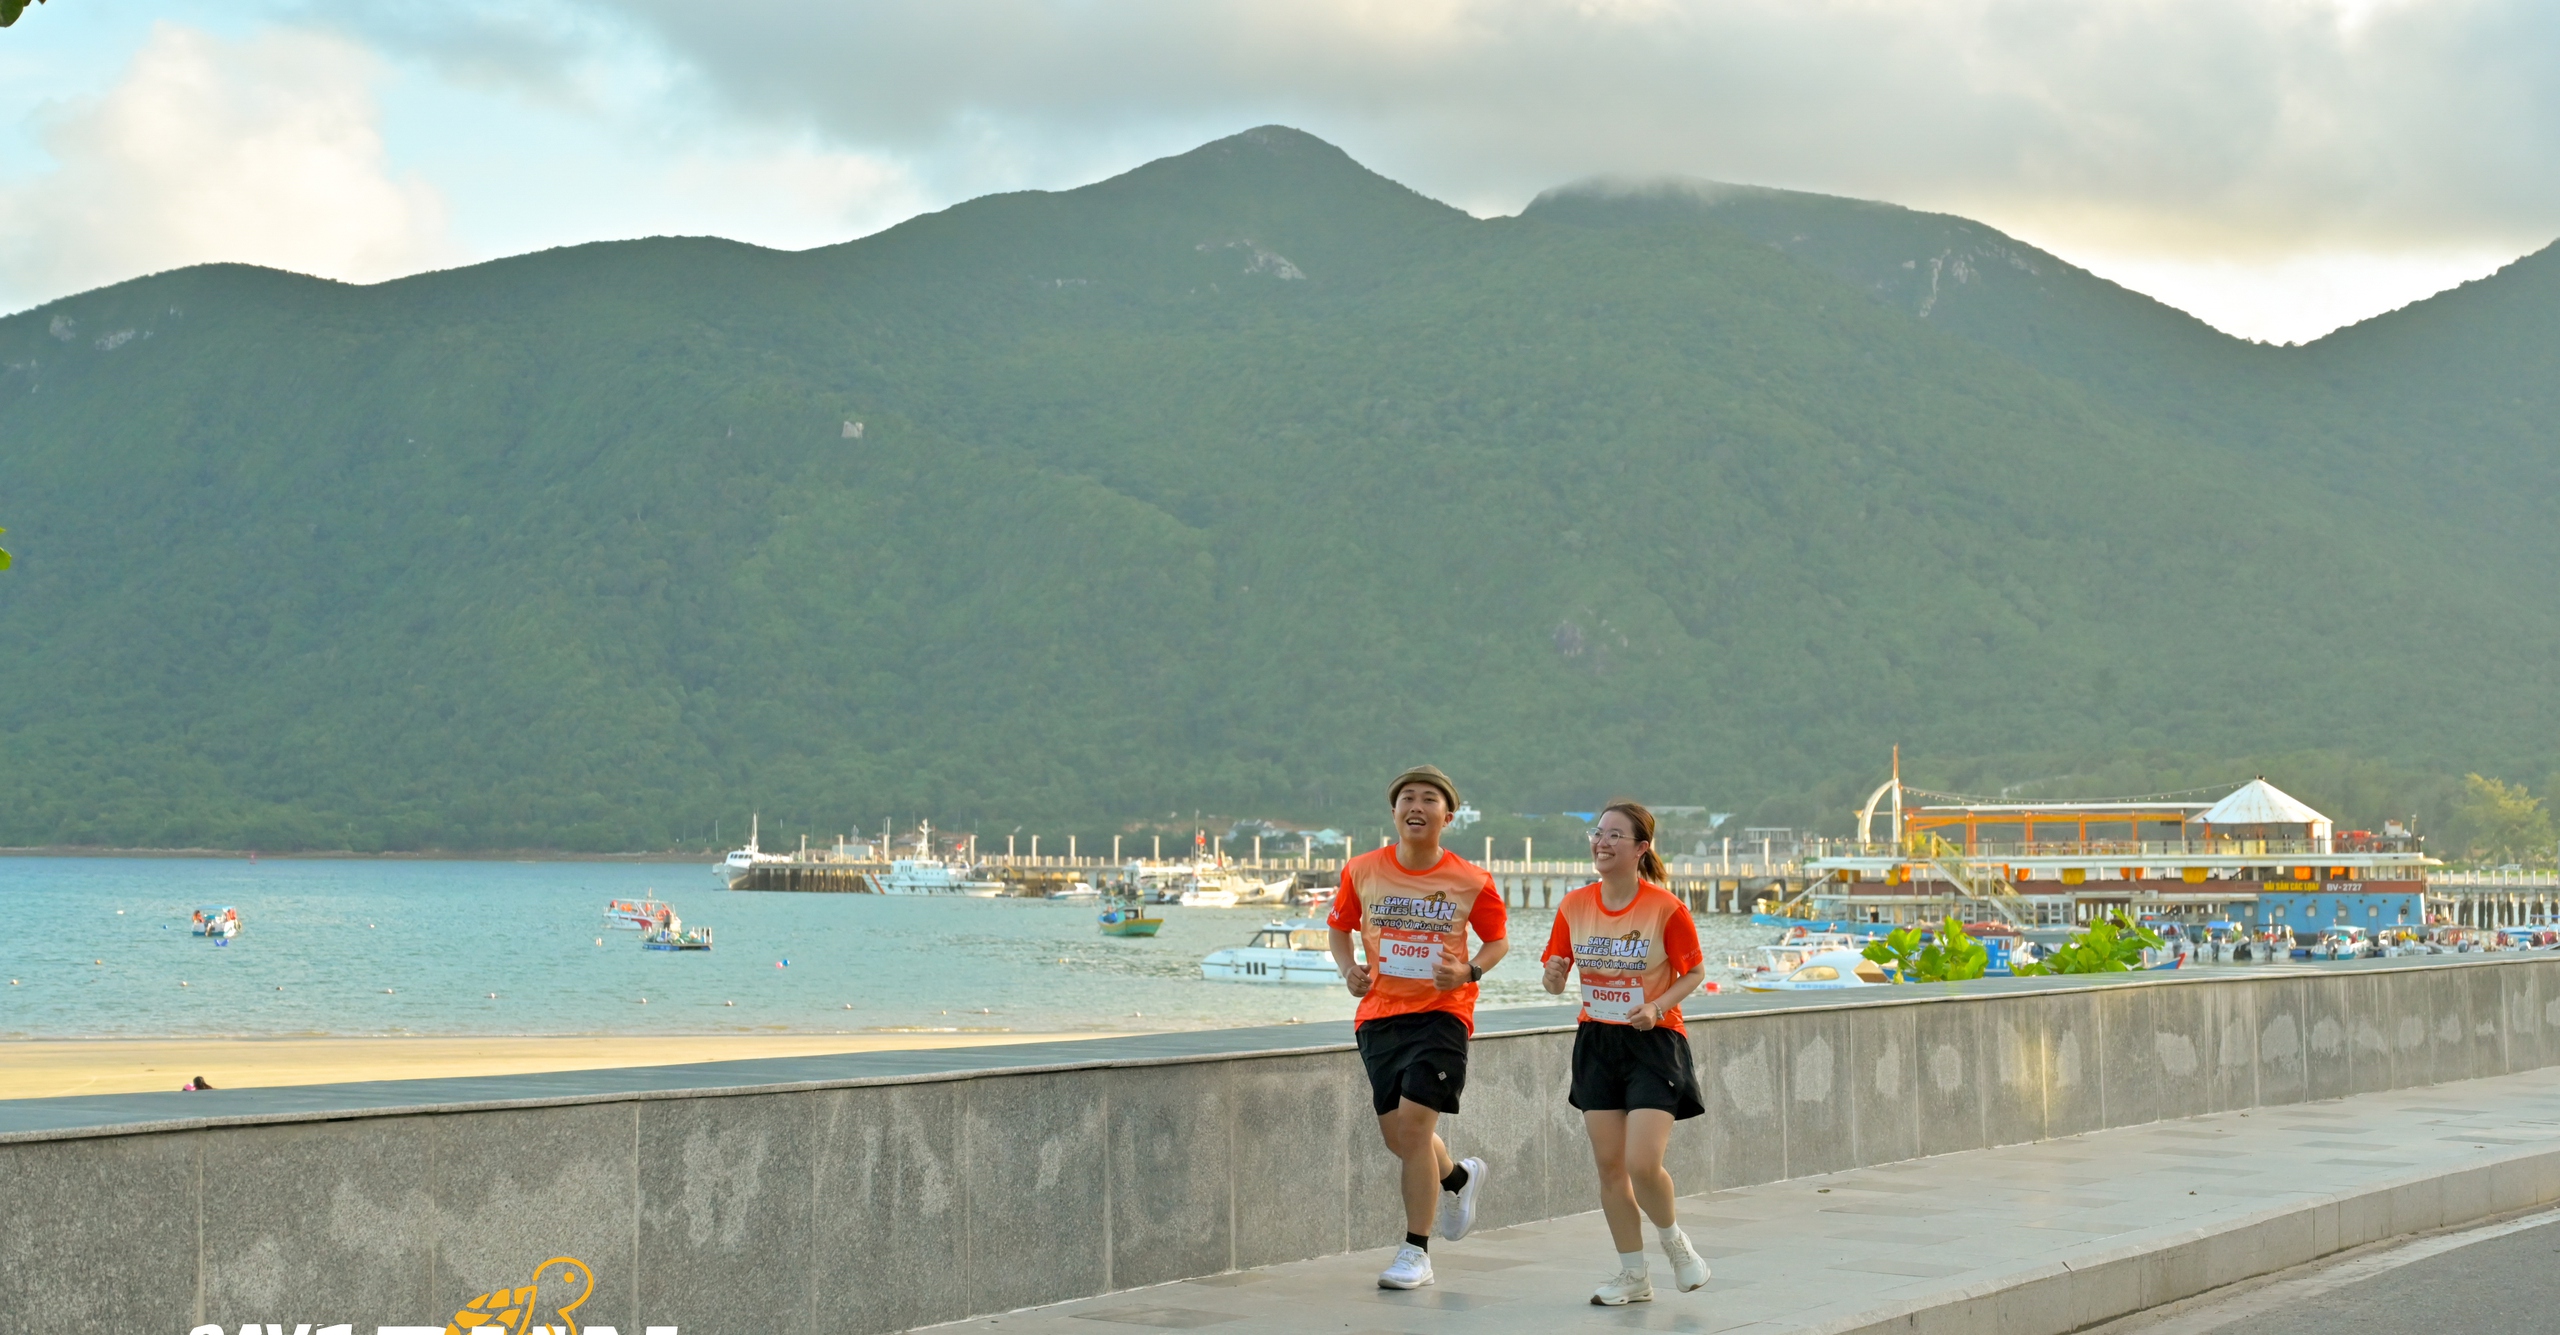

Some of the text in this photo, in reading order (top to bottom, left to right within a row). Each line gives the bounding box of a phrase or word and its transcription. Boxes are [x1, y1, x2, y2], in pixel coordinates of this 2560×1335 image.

[1384, 896, 1410, 906] SAVE
[1370, 904, 1409, 915] TURTLES
[1410, 898, 1457, 920] RUN
[1588, 936, 1611, 946] SAVE
[1391, 943, 1430, 958] 05019
[1574, 944, 1609, 956] TURTLES
[1610, 938, 1650, 958] RUN
[1590, 959, 1603, 969] BỘ
[1592, 989, 1631, 1003] 05076
